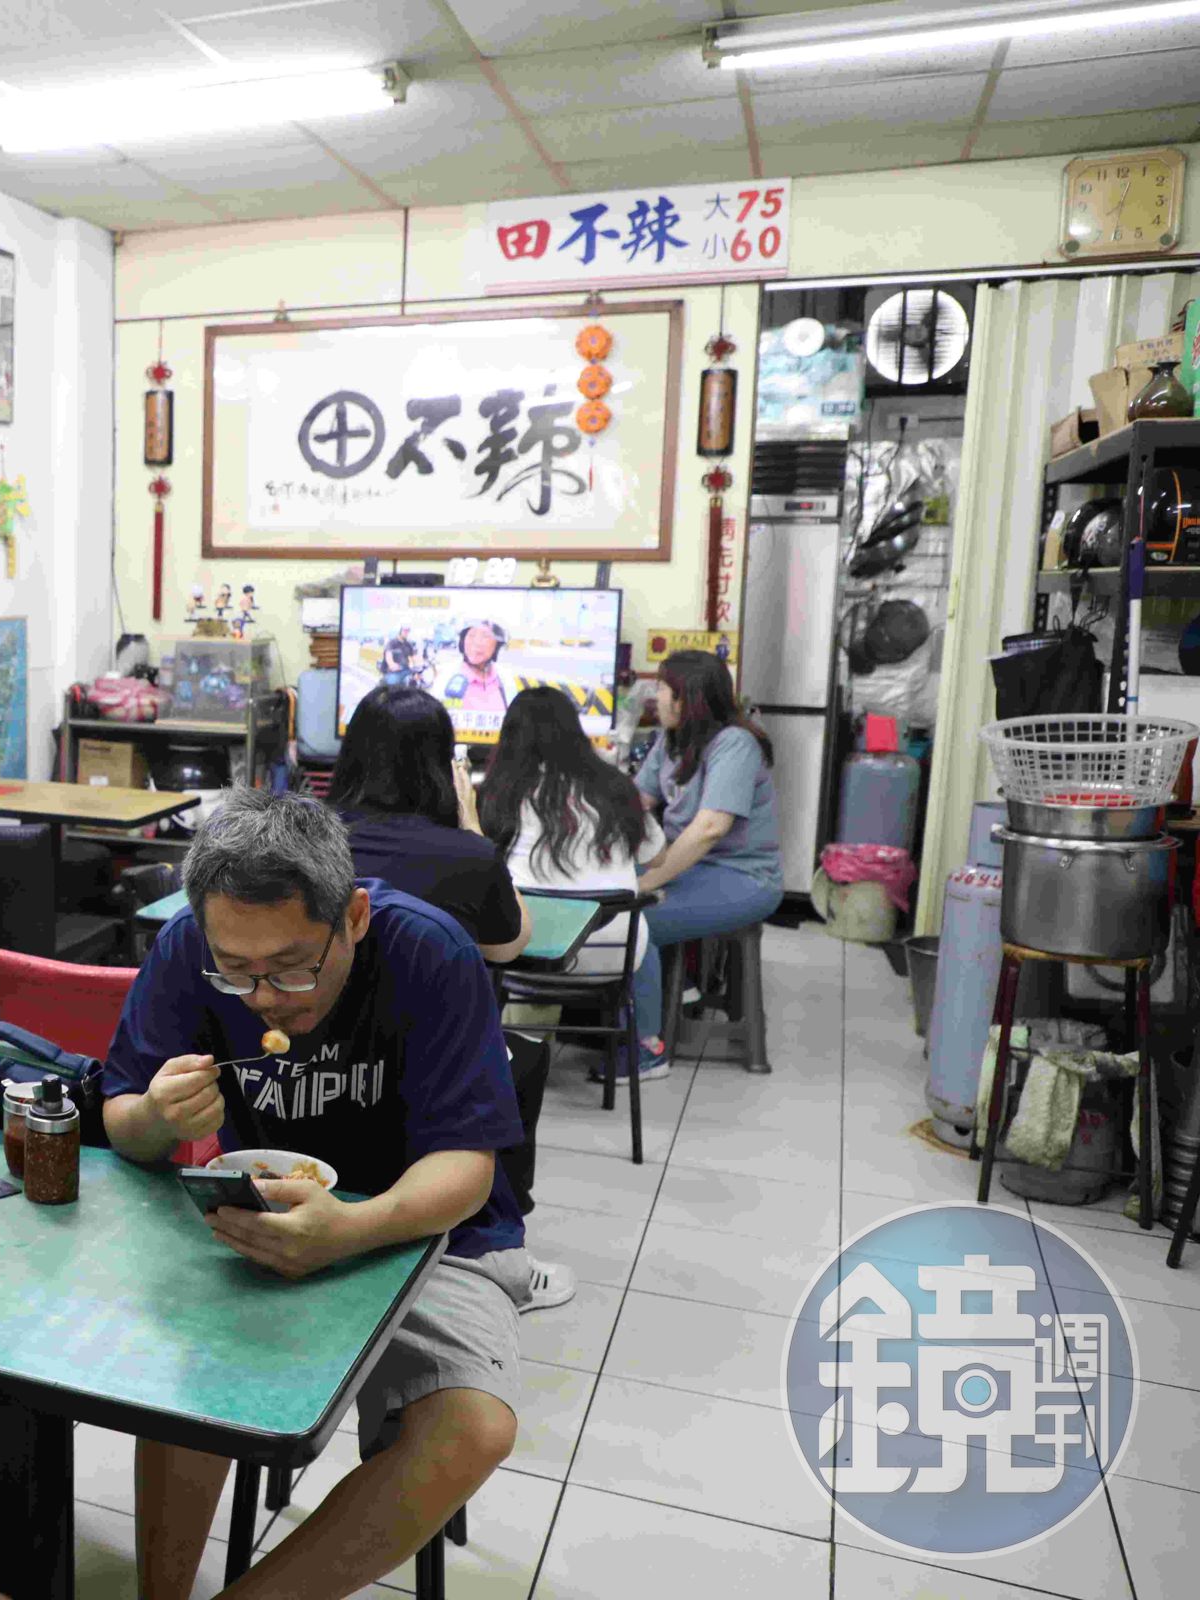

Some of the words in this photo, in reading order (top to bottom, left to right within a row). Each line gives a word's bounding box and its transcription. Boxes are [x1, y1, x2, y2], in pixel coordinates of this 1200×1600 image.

[1116, 166, 1130, 179] 12
[1155, 175, 1165, 188] 2
[1155, 194, 1165, 207] 3
[1151, 214, 1162, 226] 4
[496, 194, 690, 266] 田不辣
[275, 1043, 340, 1078] TEAM
[232, 1059, 385, 1121] TAIPEI
